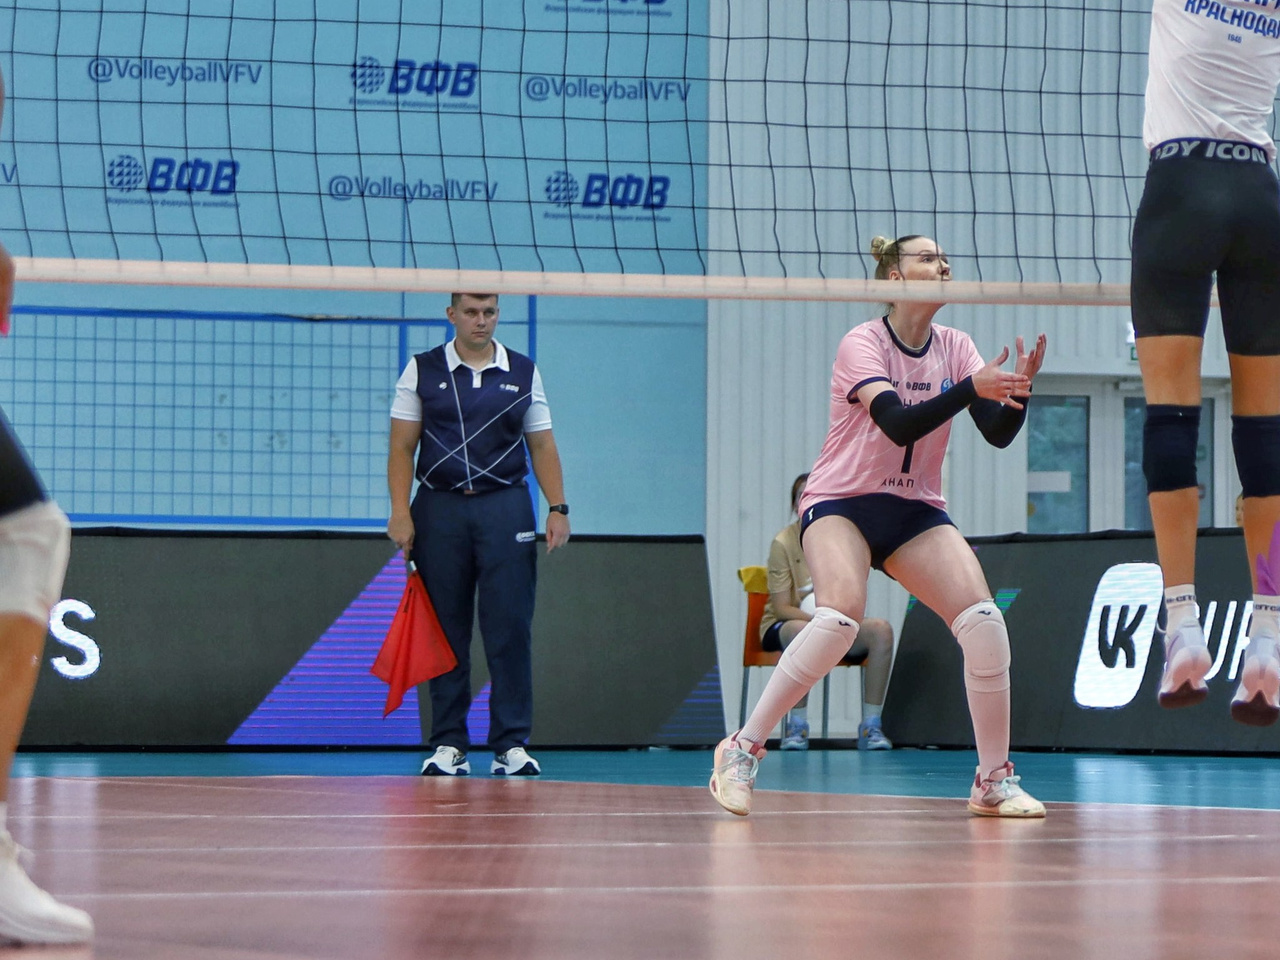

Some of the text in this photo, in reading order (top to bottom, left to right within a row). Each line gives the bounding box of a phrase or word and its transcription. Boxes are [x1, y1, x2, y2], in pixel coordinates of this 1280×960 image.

[88, 57, 262, 87] @VolleyballVFV
[387, 58, 479, 98] ВФВ
[525, 76, 692, 105] @VolleyballVFV
[1205, 141, 1267, 164] ICON
[146, 157, 241, 195] ВФВ
[328, 175, 499, 204] @VolleyballVFV
[581, 172, 671, 211] ВФВ
[911, 381, 931, 391] ВФВ
